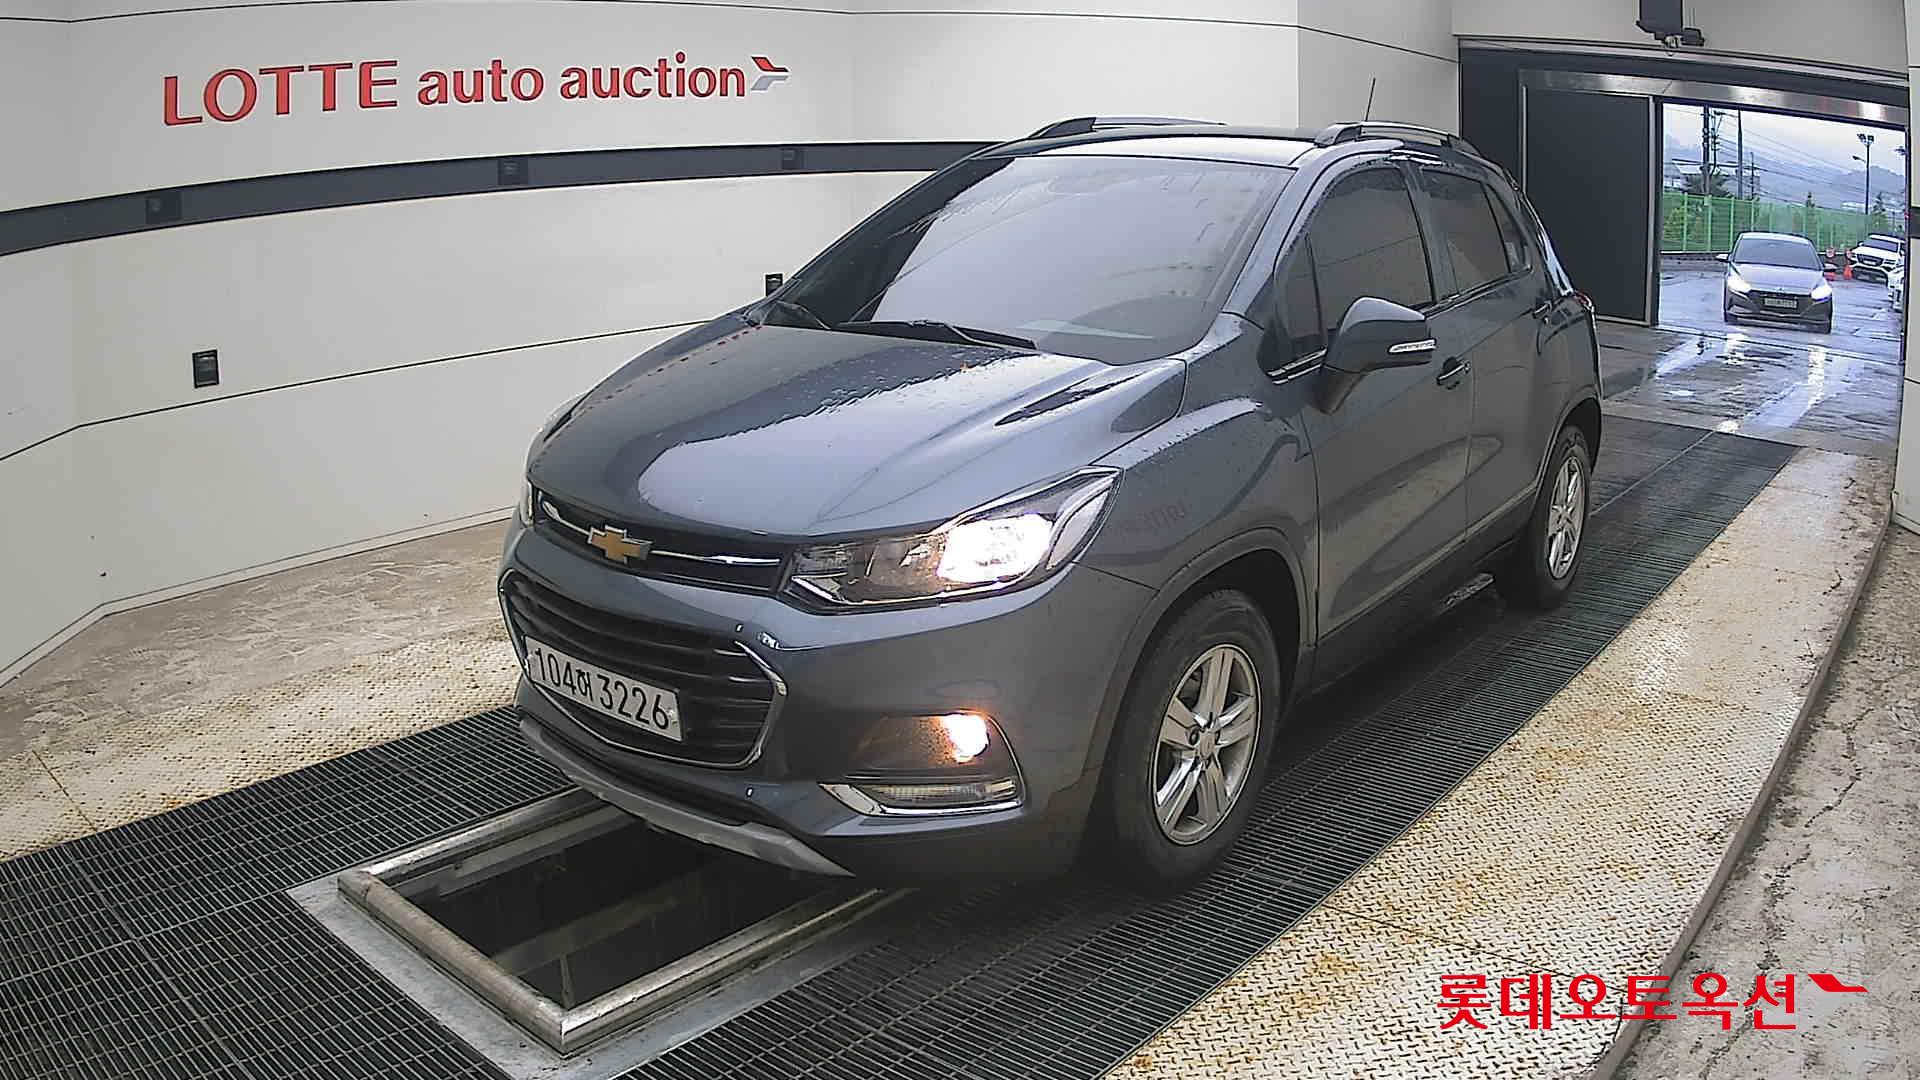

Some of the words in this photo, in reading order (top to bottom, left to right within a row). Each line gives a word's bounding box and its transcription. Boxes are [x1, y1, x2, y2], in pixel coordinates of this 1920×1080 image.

[163, 59, 398, 127] LOTTE
[417, 57, 544, 105] auto
[560, 50, 746, 99] auction
[597, 673, 669, 730] 3226
